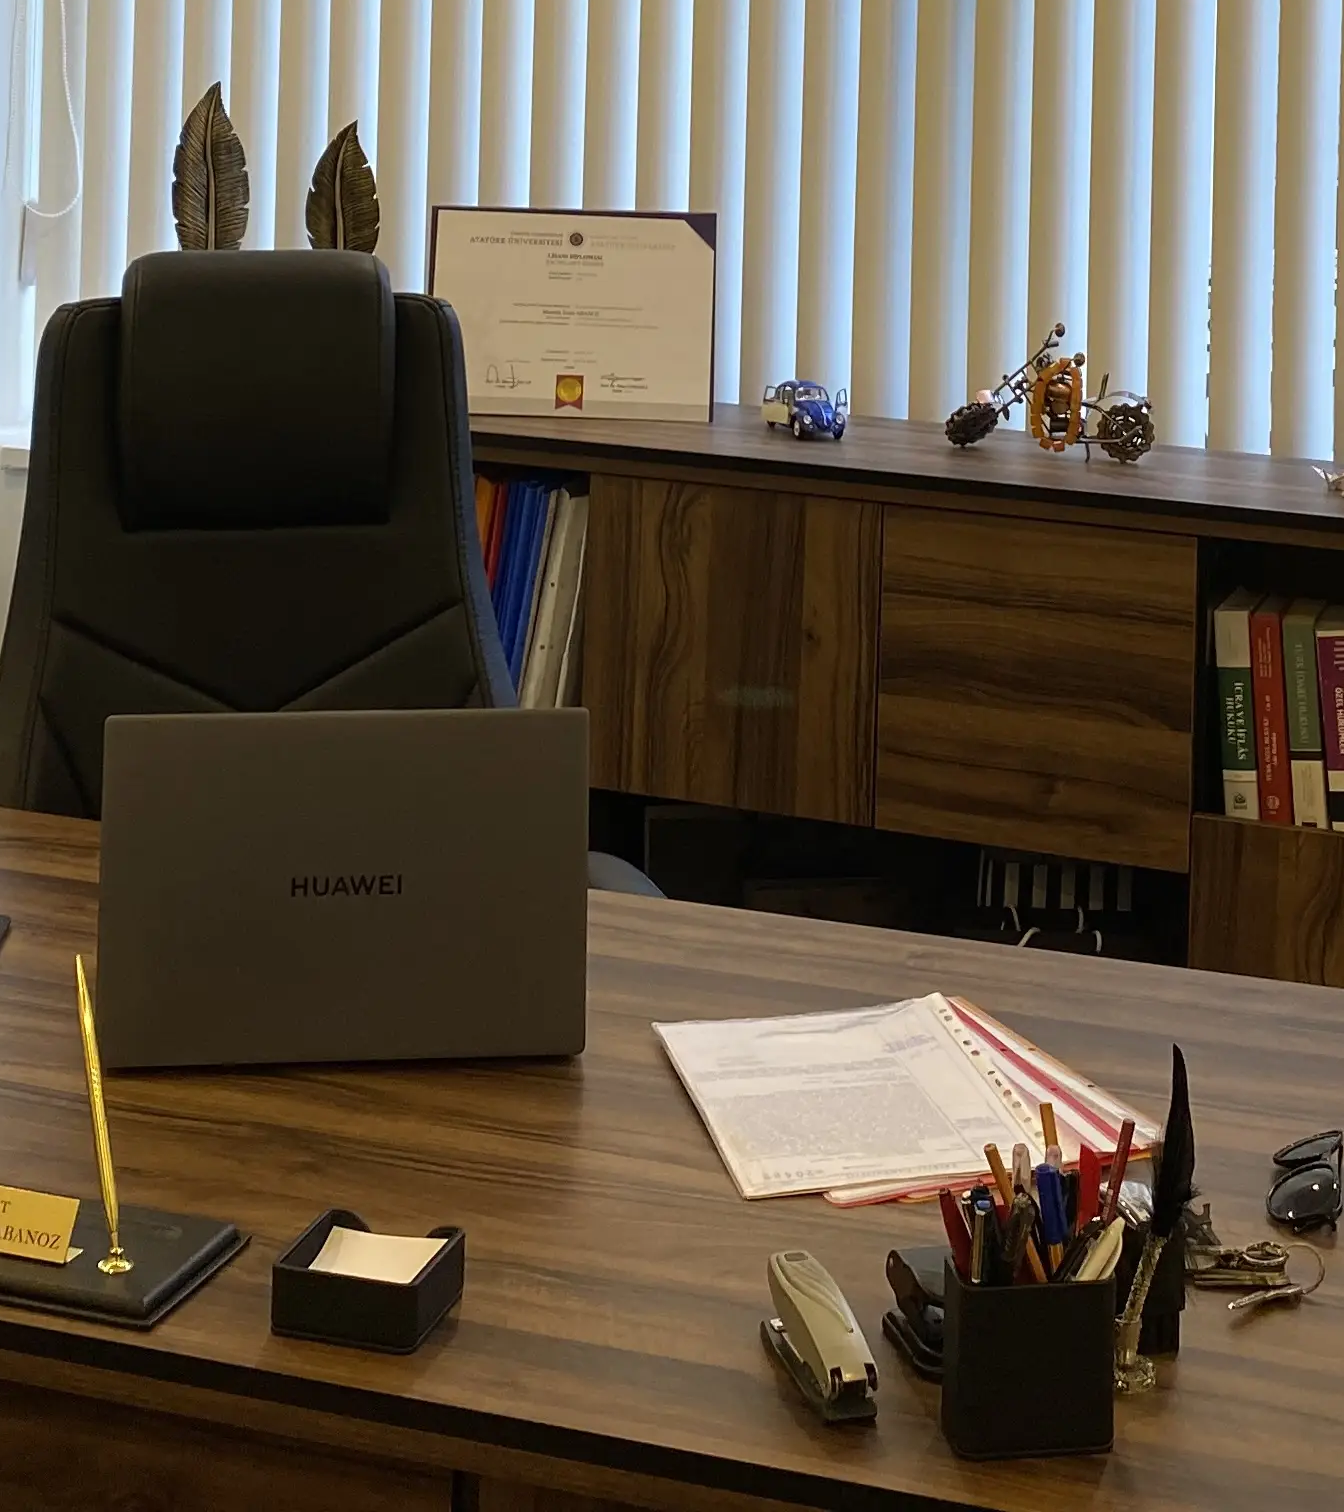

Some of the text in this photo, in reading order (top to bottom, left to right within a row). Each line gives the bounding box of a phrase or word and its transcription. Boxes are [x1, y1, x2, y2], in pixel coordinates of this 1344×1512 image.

[1233, 681, 1245, 709] İCRA
[1335, 687, 1344, 707] ÖZEL
[1225, 696, 1236, 745] HUKUKU
[1235, 712, 1246, 726] VE
[291, 874, 402, 897] HUAWEI
